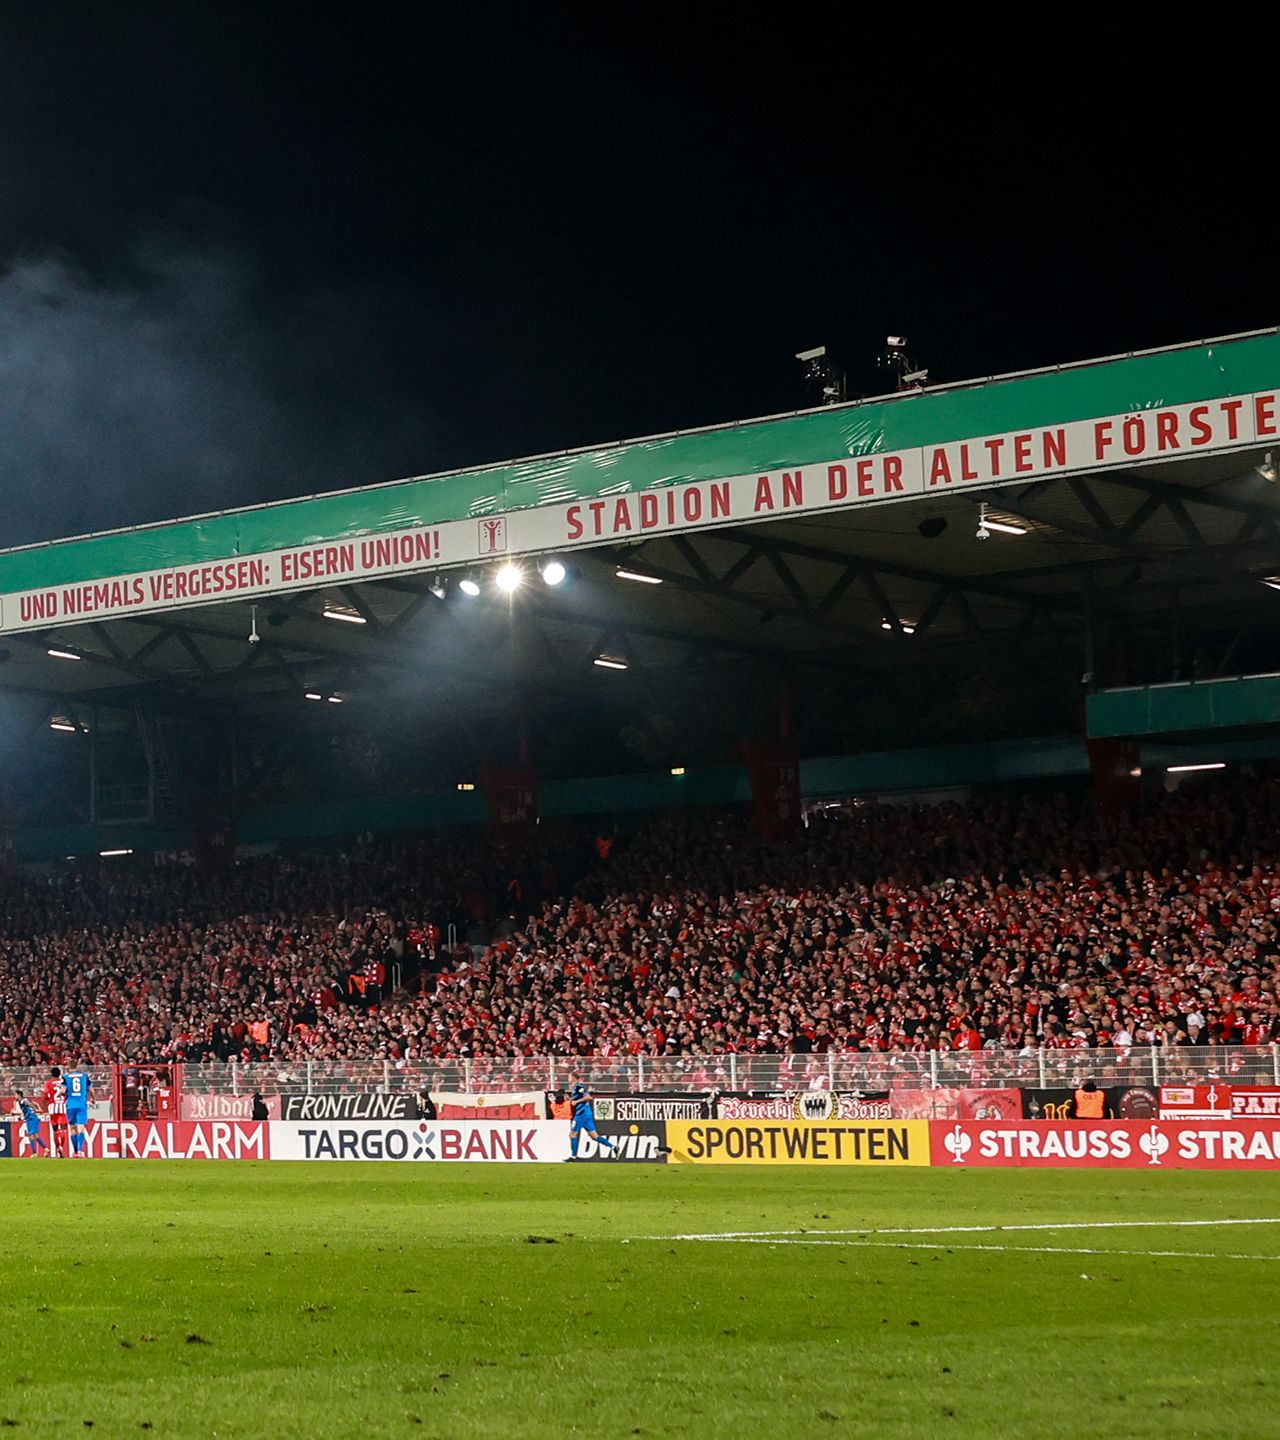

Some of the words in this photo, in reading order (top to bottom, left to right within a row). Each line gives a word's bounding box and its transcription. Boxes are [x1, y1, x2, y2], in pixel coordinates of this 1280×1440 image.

[566, 482, 732, 541] STADION
[754, 469, 805, 512] AN
[827, 454, 905, 502] DER
[929, 428, 1068, 487] ALTEN
[1094, 395, 1279, 463] FÖRSTE
[20, 592, 58, 622] UND
[63, 577, 145, 615] NIEMALS
[149, 559, 271, 602] VERGESSEN:
[280, 543, 355, 582] EISERN
[361, 531, 440, 570] UNION!
[72, 1080, 81, 1092] 6
[159, 1088, 170, 1097] Tor
[286, 1094, 407, 1120] FRONTLINE
[840, 1097, 891, 1120] Boys
[687, 1127, 908, 1160] SPORTWETTEN
[980, 1130, 1131, 1159] STRAUSS
